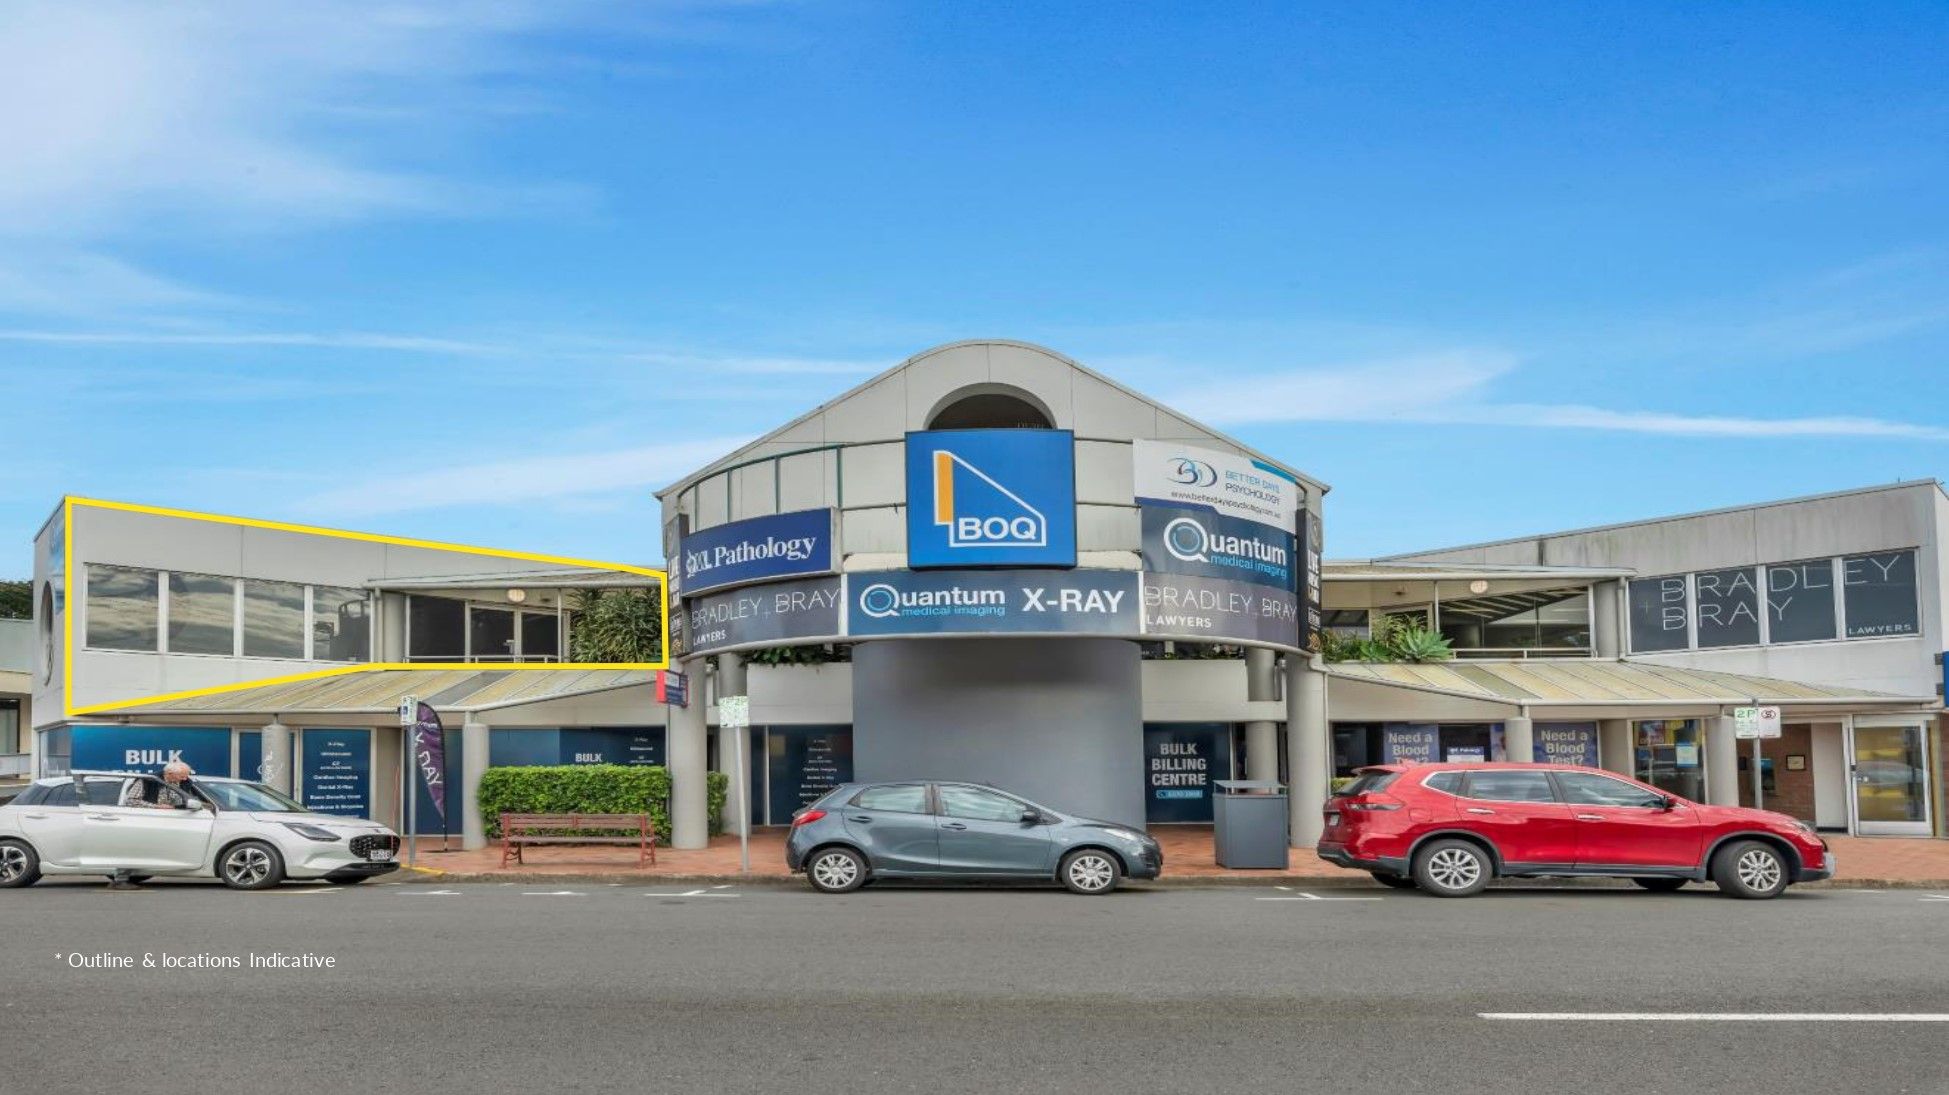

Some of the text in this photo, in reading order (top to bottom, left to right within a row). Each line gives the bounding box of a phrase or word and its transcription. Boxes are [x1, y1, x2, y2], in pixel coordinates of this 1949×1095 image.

[958, 516, 1036, 540] BOQ
[1164, 517, 1287, 566] Quantum
[714, 536, 817, 568] Pathology
[1210, 554, 1287, 579] medical imaging
[1661, 555, 1899, 603] BRADLEY
[859, 583, 1006, 617] Quantum
[1022, 588, 1125, 612] X-RAY
[1144, 585, 1252, 614] BRADLEY
[1262, 598, 1297, 622] BRAY
[691, 597, 763, 630] BRADLEY
[774, 587, 841, 614] BRAY
[901, 605, 1006, 617] medical imaging
[1662, 596, 1793, 631] BRAY
[1146, 614, 1212, 629] LAWYERS
[693, 629, 727, 646] LAWYERS
[1848, 624, 1912, 636] LAWYERS
[1389, 732, 1432, 743] Need a
[1540, 730, 1589, 741] Need a
[1160, 743, 1198, 755] BULK
[1392, 744, 1430, 756] Blood
[1545, 742, 1586, 754] Blood
[125, 749, 184, 765] BULK
[1151, 758, 1207, 771] BILLING
[1151, 773, 1208, 786] CENTRE
